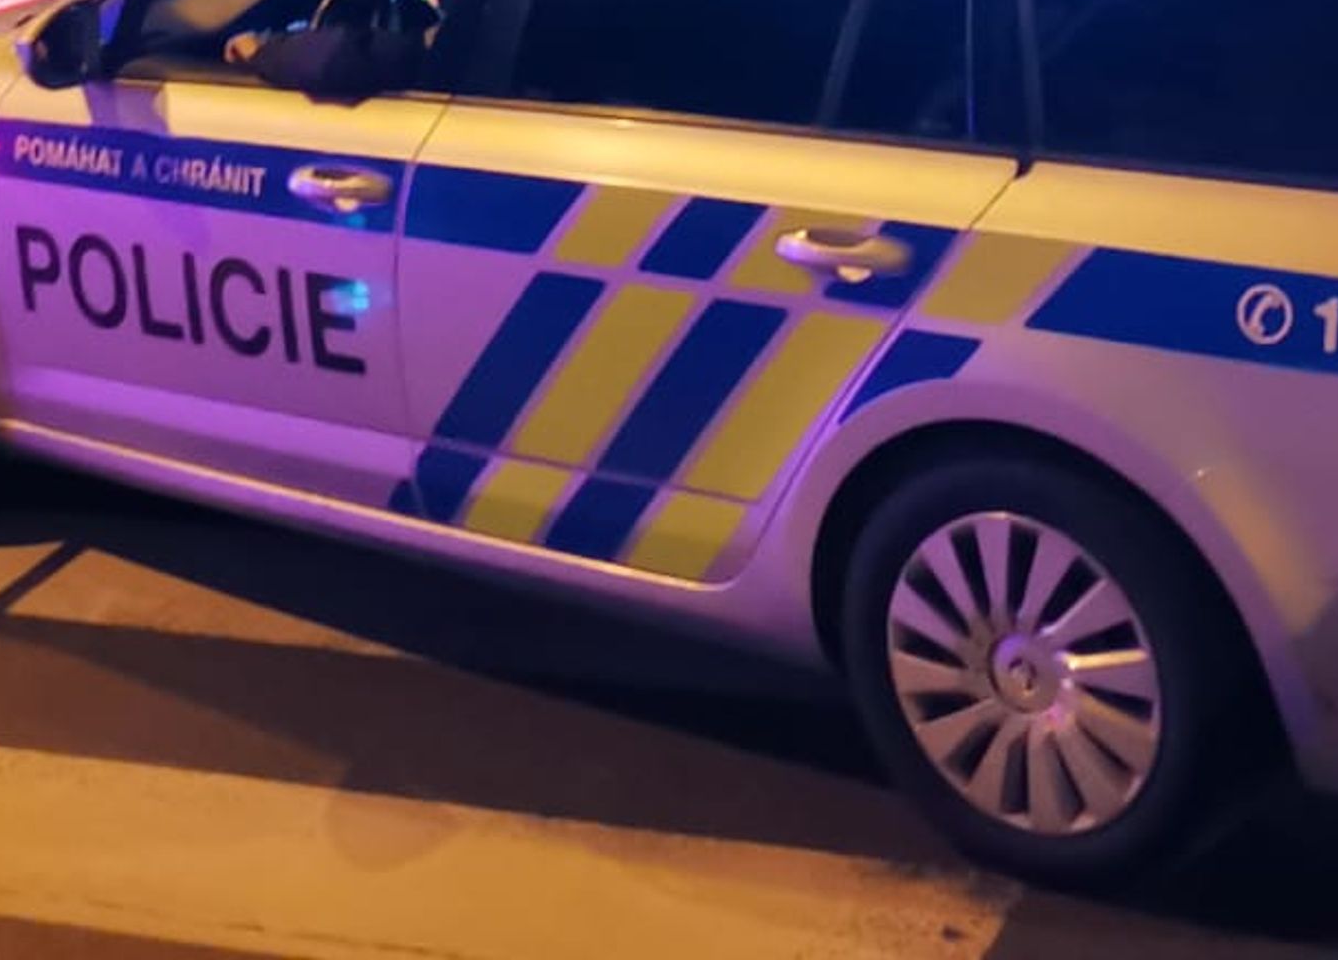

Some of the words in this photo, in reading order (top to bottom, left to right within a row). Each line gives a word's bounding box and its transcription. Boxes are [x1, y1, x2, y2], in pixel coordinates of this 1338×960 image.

[14, 134, 123, 178] POMÁHAT
[129, 153, 149, 181] A
[153, 155, 267, 197] CHRÁNIT
[16, 225, 367, 375] POLICIE
